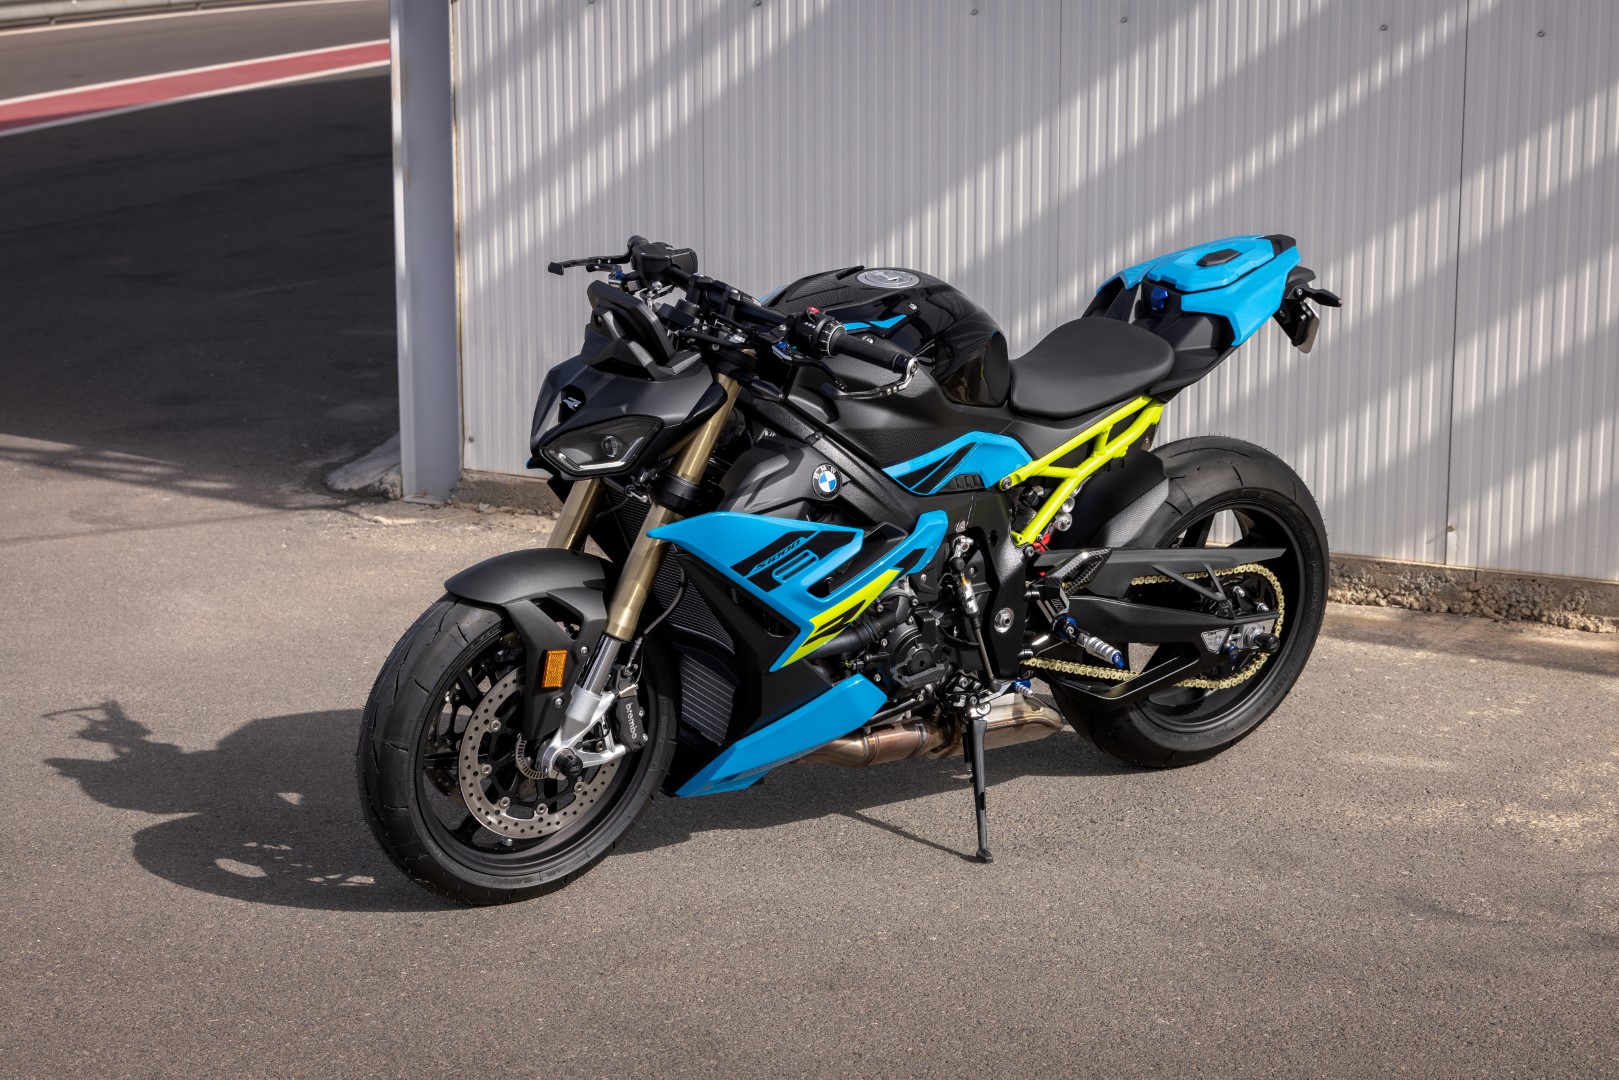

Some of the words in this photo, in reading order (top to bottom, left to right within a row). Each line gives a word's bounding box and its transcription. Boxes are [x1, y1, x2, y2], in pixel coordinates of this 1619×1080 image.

[813, 464, 837, 480] BMW
[753, 539, 802, 572] S1000
[625, 702, 638, 740] brembo
